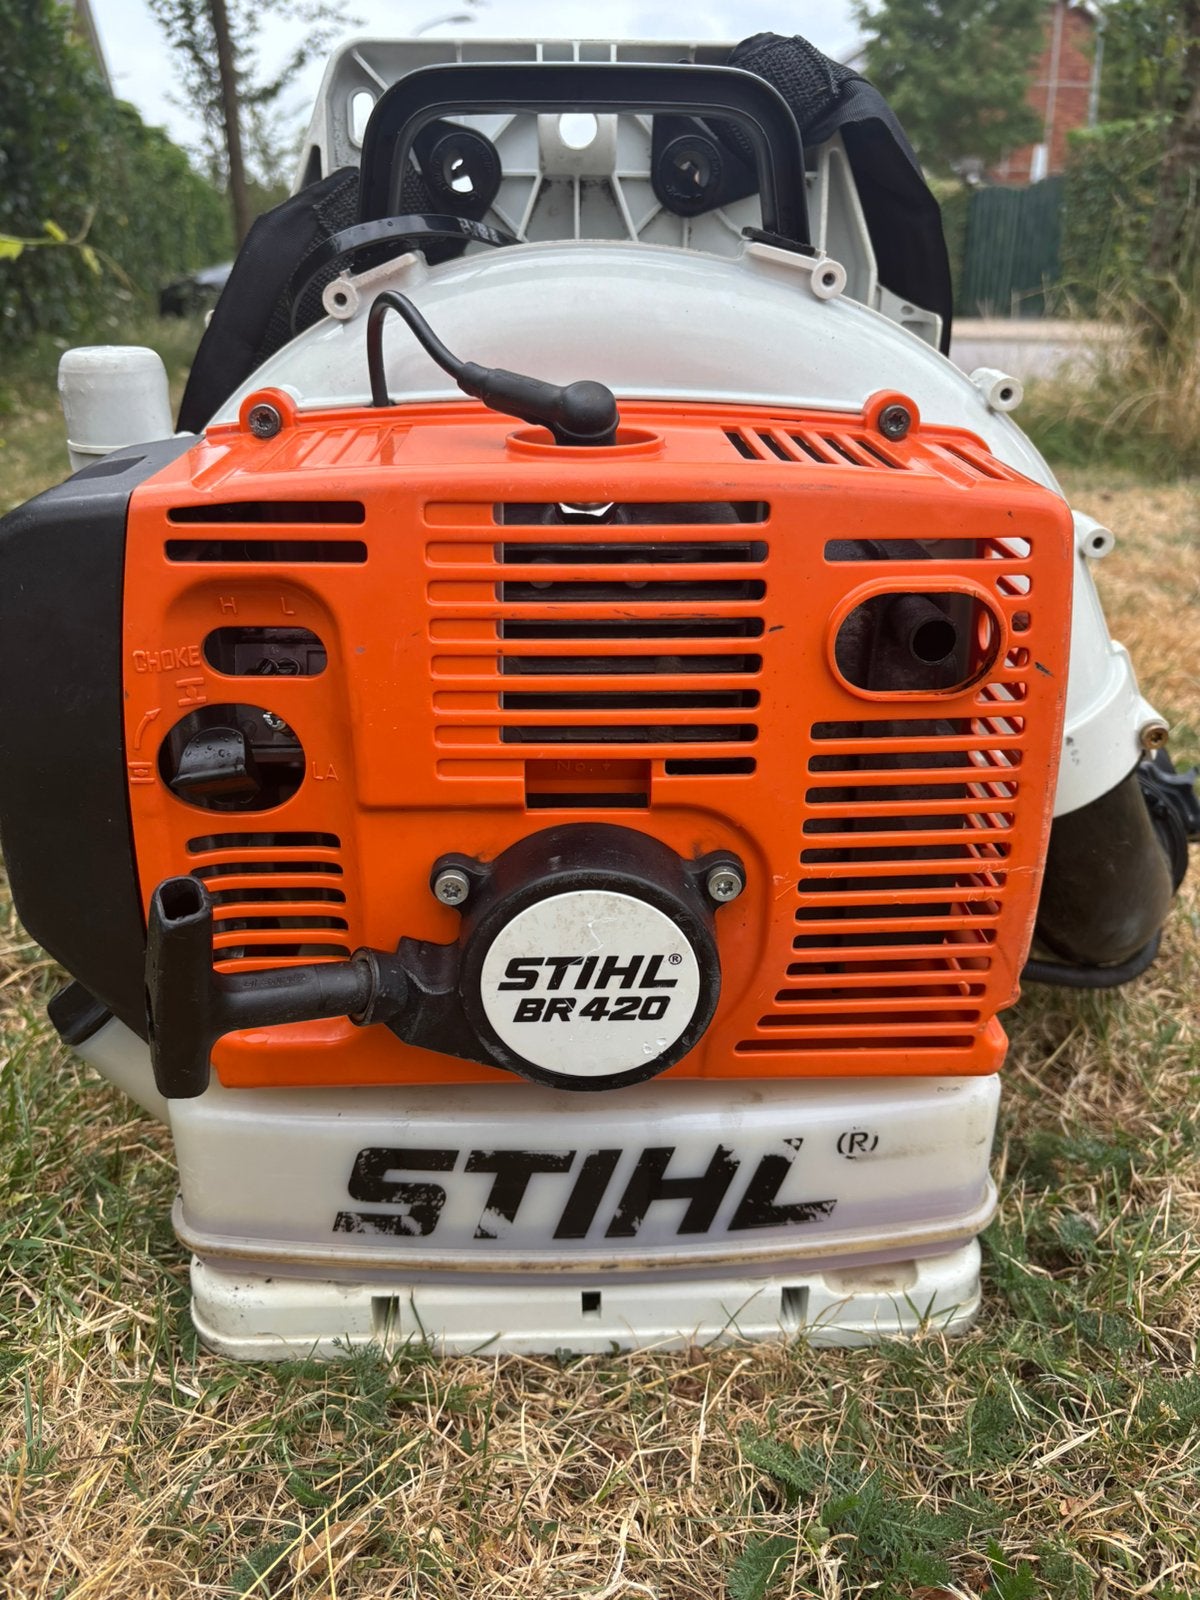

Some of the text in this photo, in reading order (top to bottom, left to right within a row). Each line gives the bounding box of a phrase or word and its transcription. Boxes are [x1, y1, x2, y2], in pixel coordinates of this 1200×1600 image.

[219, 596, 238, 614] H
[280, 596, 296, 615] L
[132, 645, 202, 673] CHOKE
[312, 761, 339, 781] LA
[512, 996, 671, 1023] BR 420
[332, 1137, 838, 1240] STIHL
